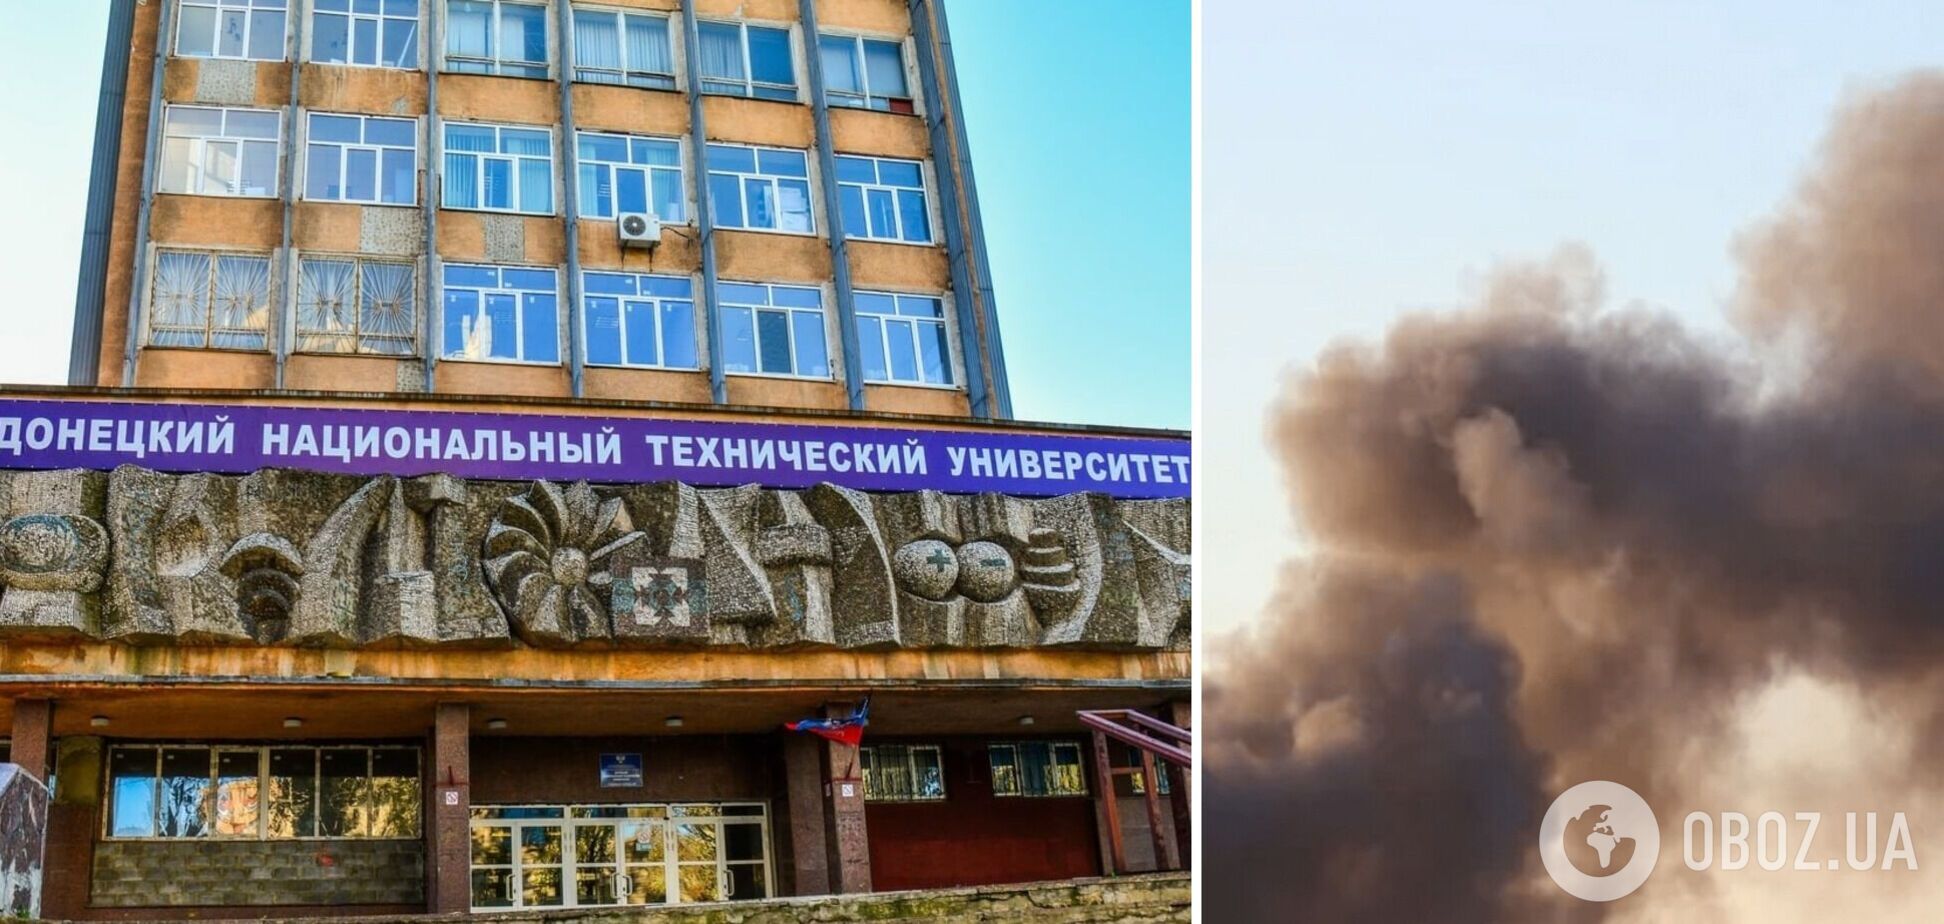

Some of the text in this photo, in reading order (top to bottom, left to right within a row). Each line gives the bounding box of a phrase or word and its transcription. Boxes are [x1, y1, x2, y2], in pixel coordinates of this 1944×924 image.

[0, 414, 1191, 484] ДОНЕЦКИЙ НАЦИОНАЛЬНЫЙ ТЕХНИЧЕСКИЙ УНИВЕРСИТЕТ
